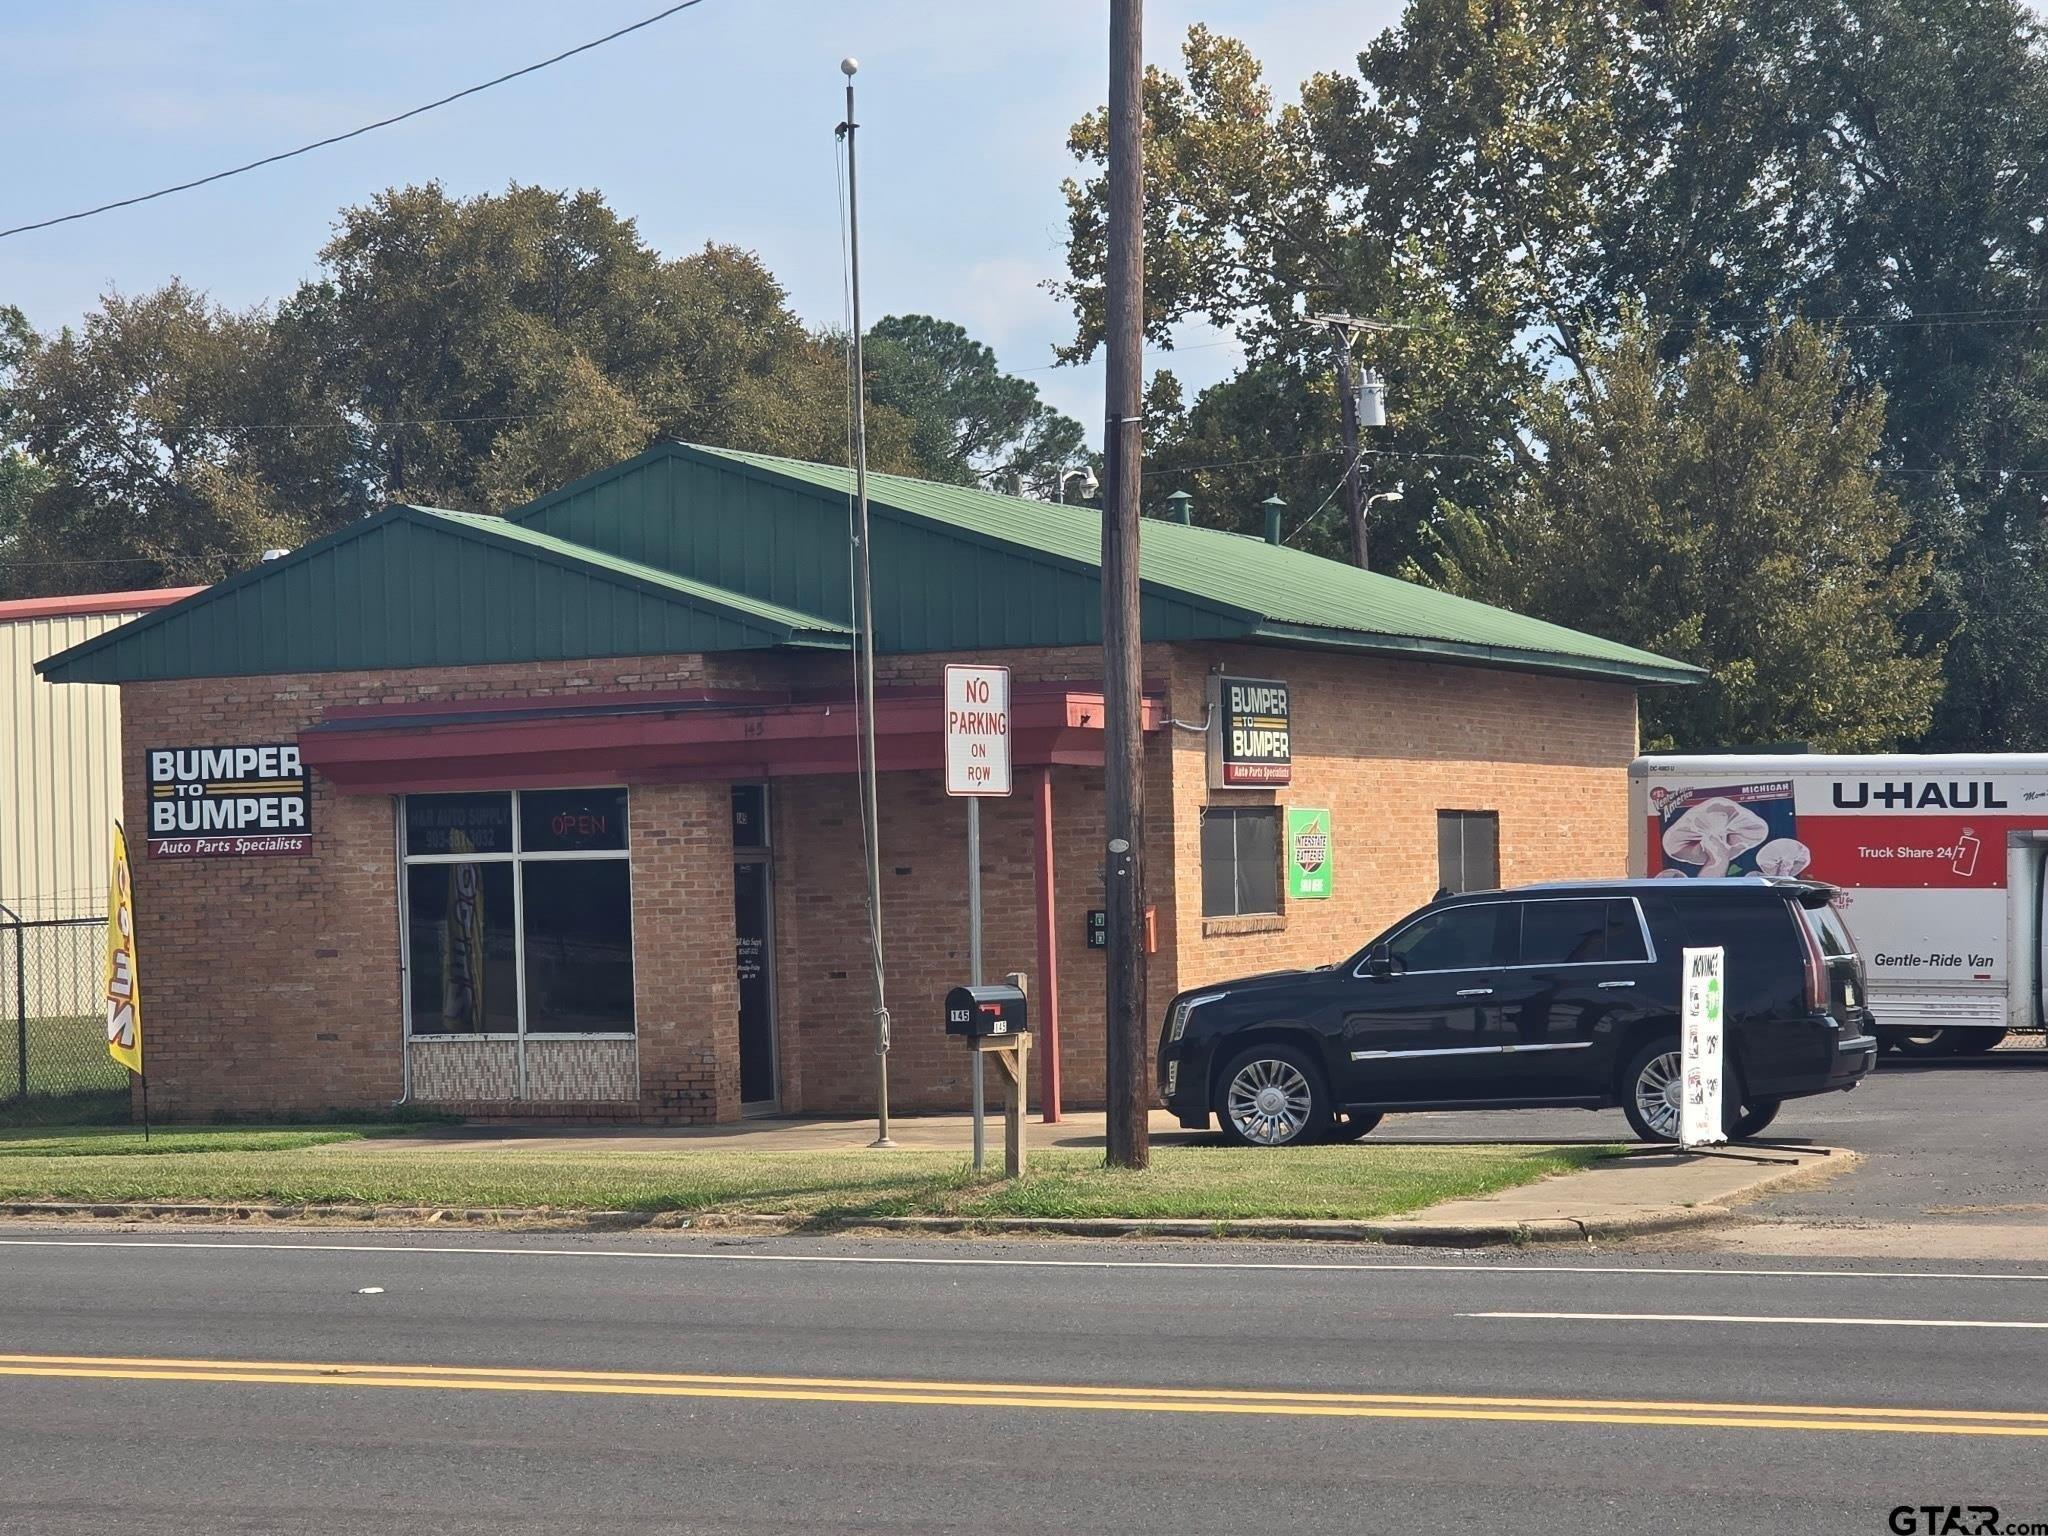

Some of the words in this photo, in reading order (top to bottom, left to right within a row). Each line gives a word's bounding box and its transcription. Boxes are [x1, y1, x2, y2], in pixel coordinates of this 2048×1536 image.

[966, 680, 989, 703] NO
[1231, 687, 1287, 715] BUMPER
[949, 712, 1006, 735] PARKING
[1242, 716, 1253, 727] TO
[971, 744, 985, 757] ON
[1233, 730, 1289, 758] BUMPER
[152, 746, 303, 781] BUMPER
[968, 767, 990, 780] ROW
[1234, 766, 1248, 778] Auto
[1249, 766, 1262, 778] Parts
[175, 784, 203, 797] TO
[1742, 783, 1788, 793] MICHIGAN
[1833, 782, 2007, 809] U-HAUL
[1663, 790, 1693, 823] America
[153, 797, 305, 832] BUMPER
[437, 808, 465, 826] AUTO
[552, 815, 607, 835] OPEN
[157, 840, 191, 854] Auto
[196, 839, 230, 853] Parts
[234, 837, 302, 854] Specialists
[1295, 835, 1327, 847] INTERSTATE
[1296, 849, 1325, 861] BATTERIES
[1858, 847, 1894, 858] Truck
[1897, 847, 1934, 858] Share
[1936, 845, 1966, 860] 24/7
[1875, 953, 1962, 967] Gentle-Ride
[1968, 954, 1994, 967] Van
[951, 1010, 969, 1021] 145
[994, 1021, 1007, 1033] 145
